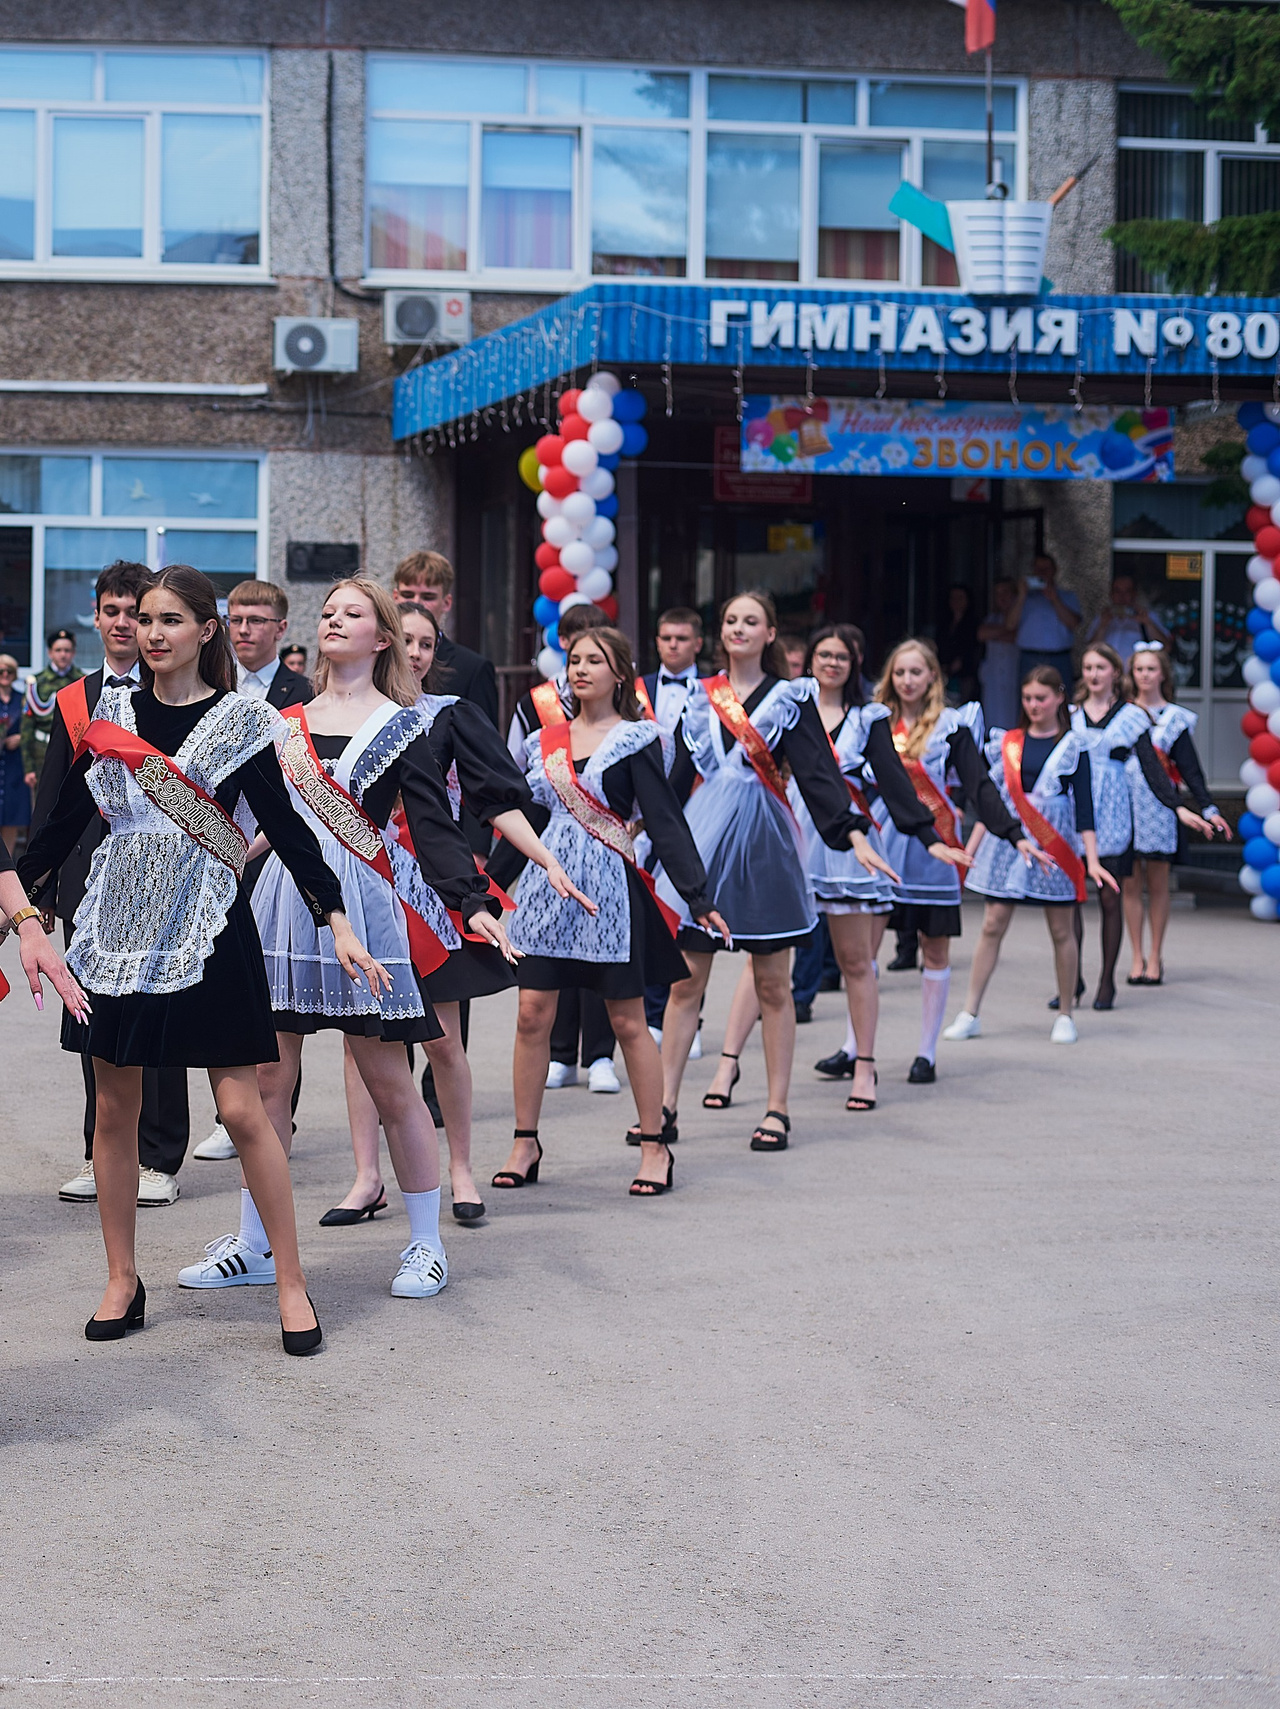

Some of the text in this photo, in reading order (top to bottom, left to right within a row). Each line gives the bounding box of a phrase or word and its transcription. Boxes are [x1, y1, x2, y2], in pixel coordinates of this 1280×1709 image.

[710, 300, 1280, 360] ГИМНАЗИЯ № 80
[913, 437, 1081, 472] ЗВОНОК
[342, 819, 383, 858] 2024
